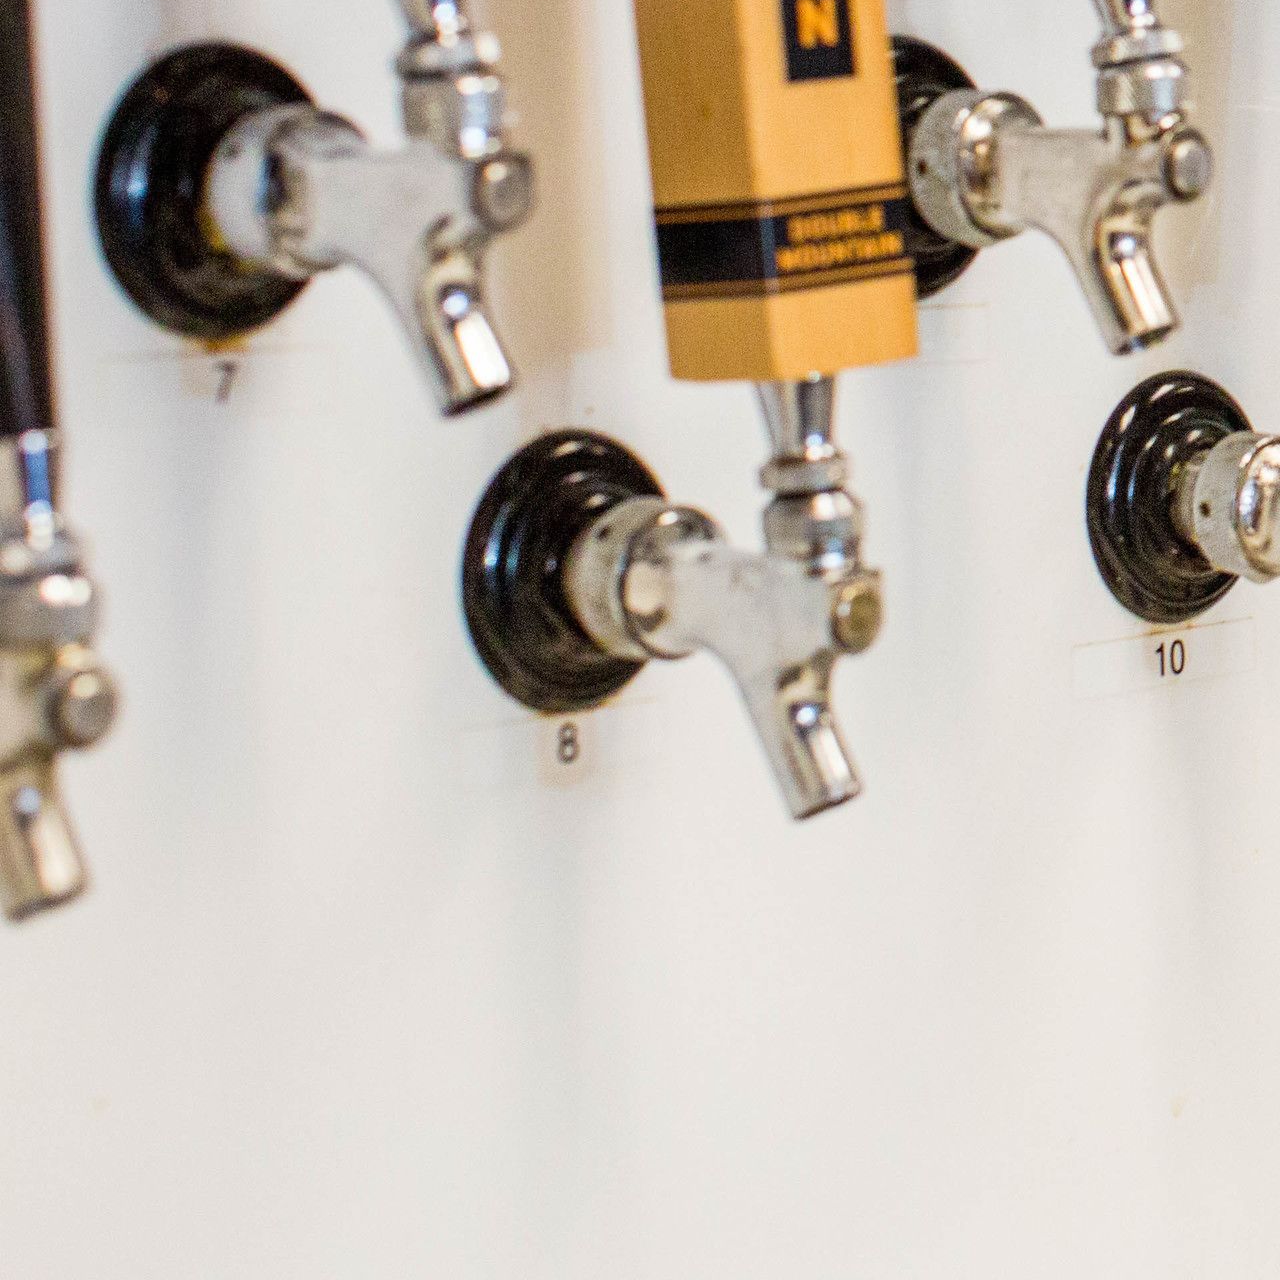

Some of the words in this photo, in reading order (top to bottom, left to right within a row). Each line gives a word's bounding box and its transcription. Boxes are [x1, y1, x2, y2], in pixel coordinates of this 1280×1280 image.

[215, 360, 239, 404] 7
[1155, 639, 1185, 677] 10
[558, 721, 580, 765] 8
